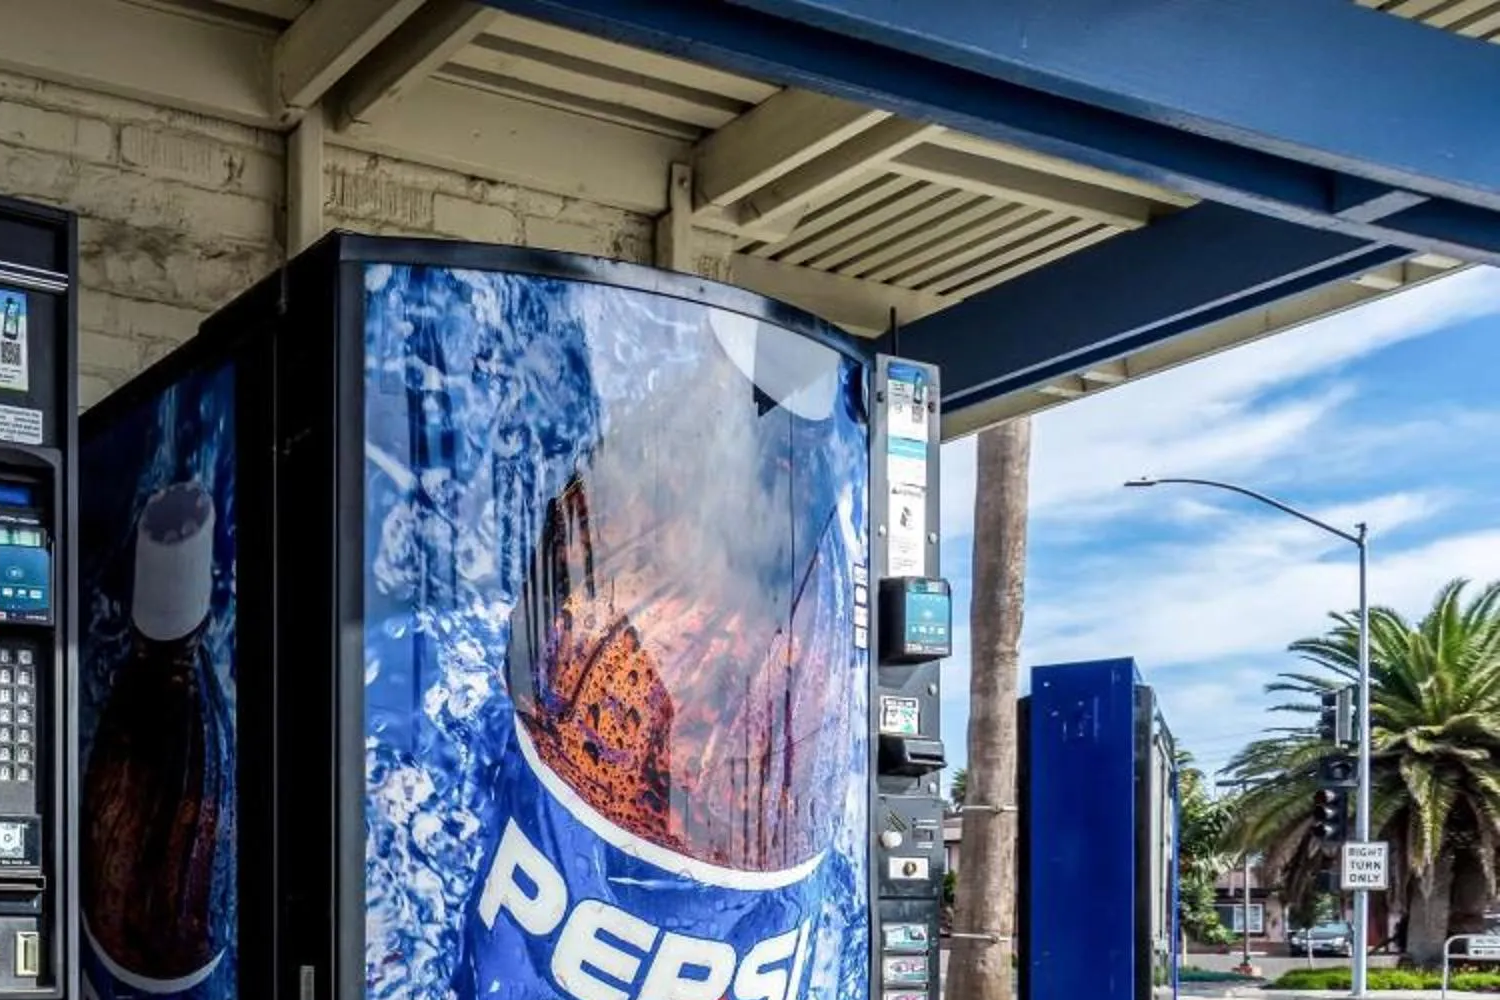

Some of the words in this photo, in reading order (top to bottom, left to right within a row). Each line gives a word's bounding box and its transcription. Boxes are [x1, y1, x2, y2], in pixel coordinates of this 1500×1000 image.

[1348, 847, 1383, 856] RIGHT
[1350, 860, 1381, 870] TURN
[1349, 873, 1381, 883] ONLY
